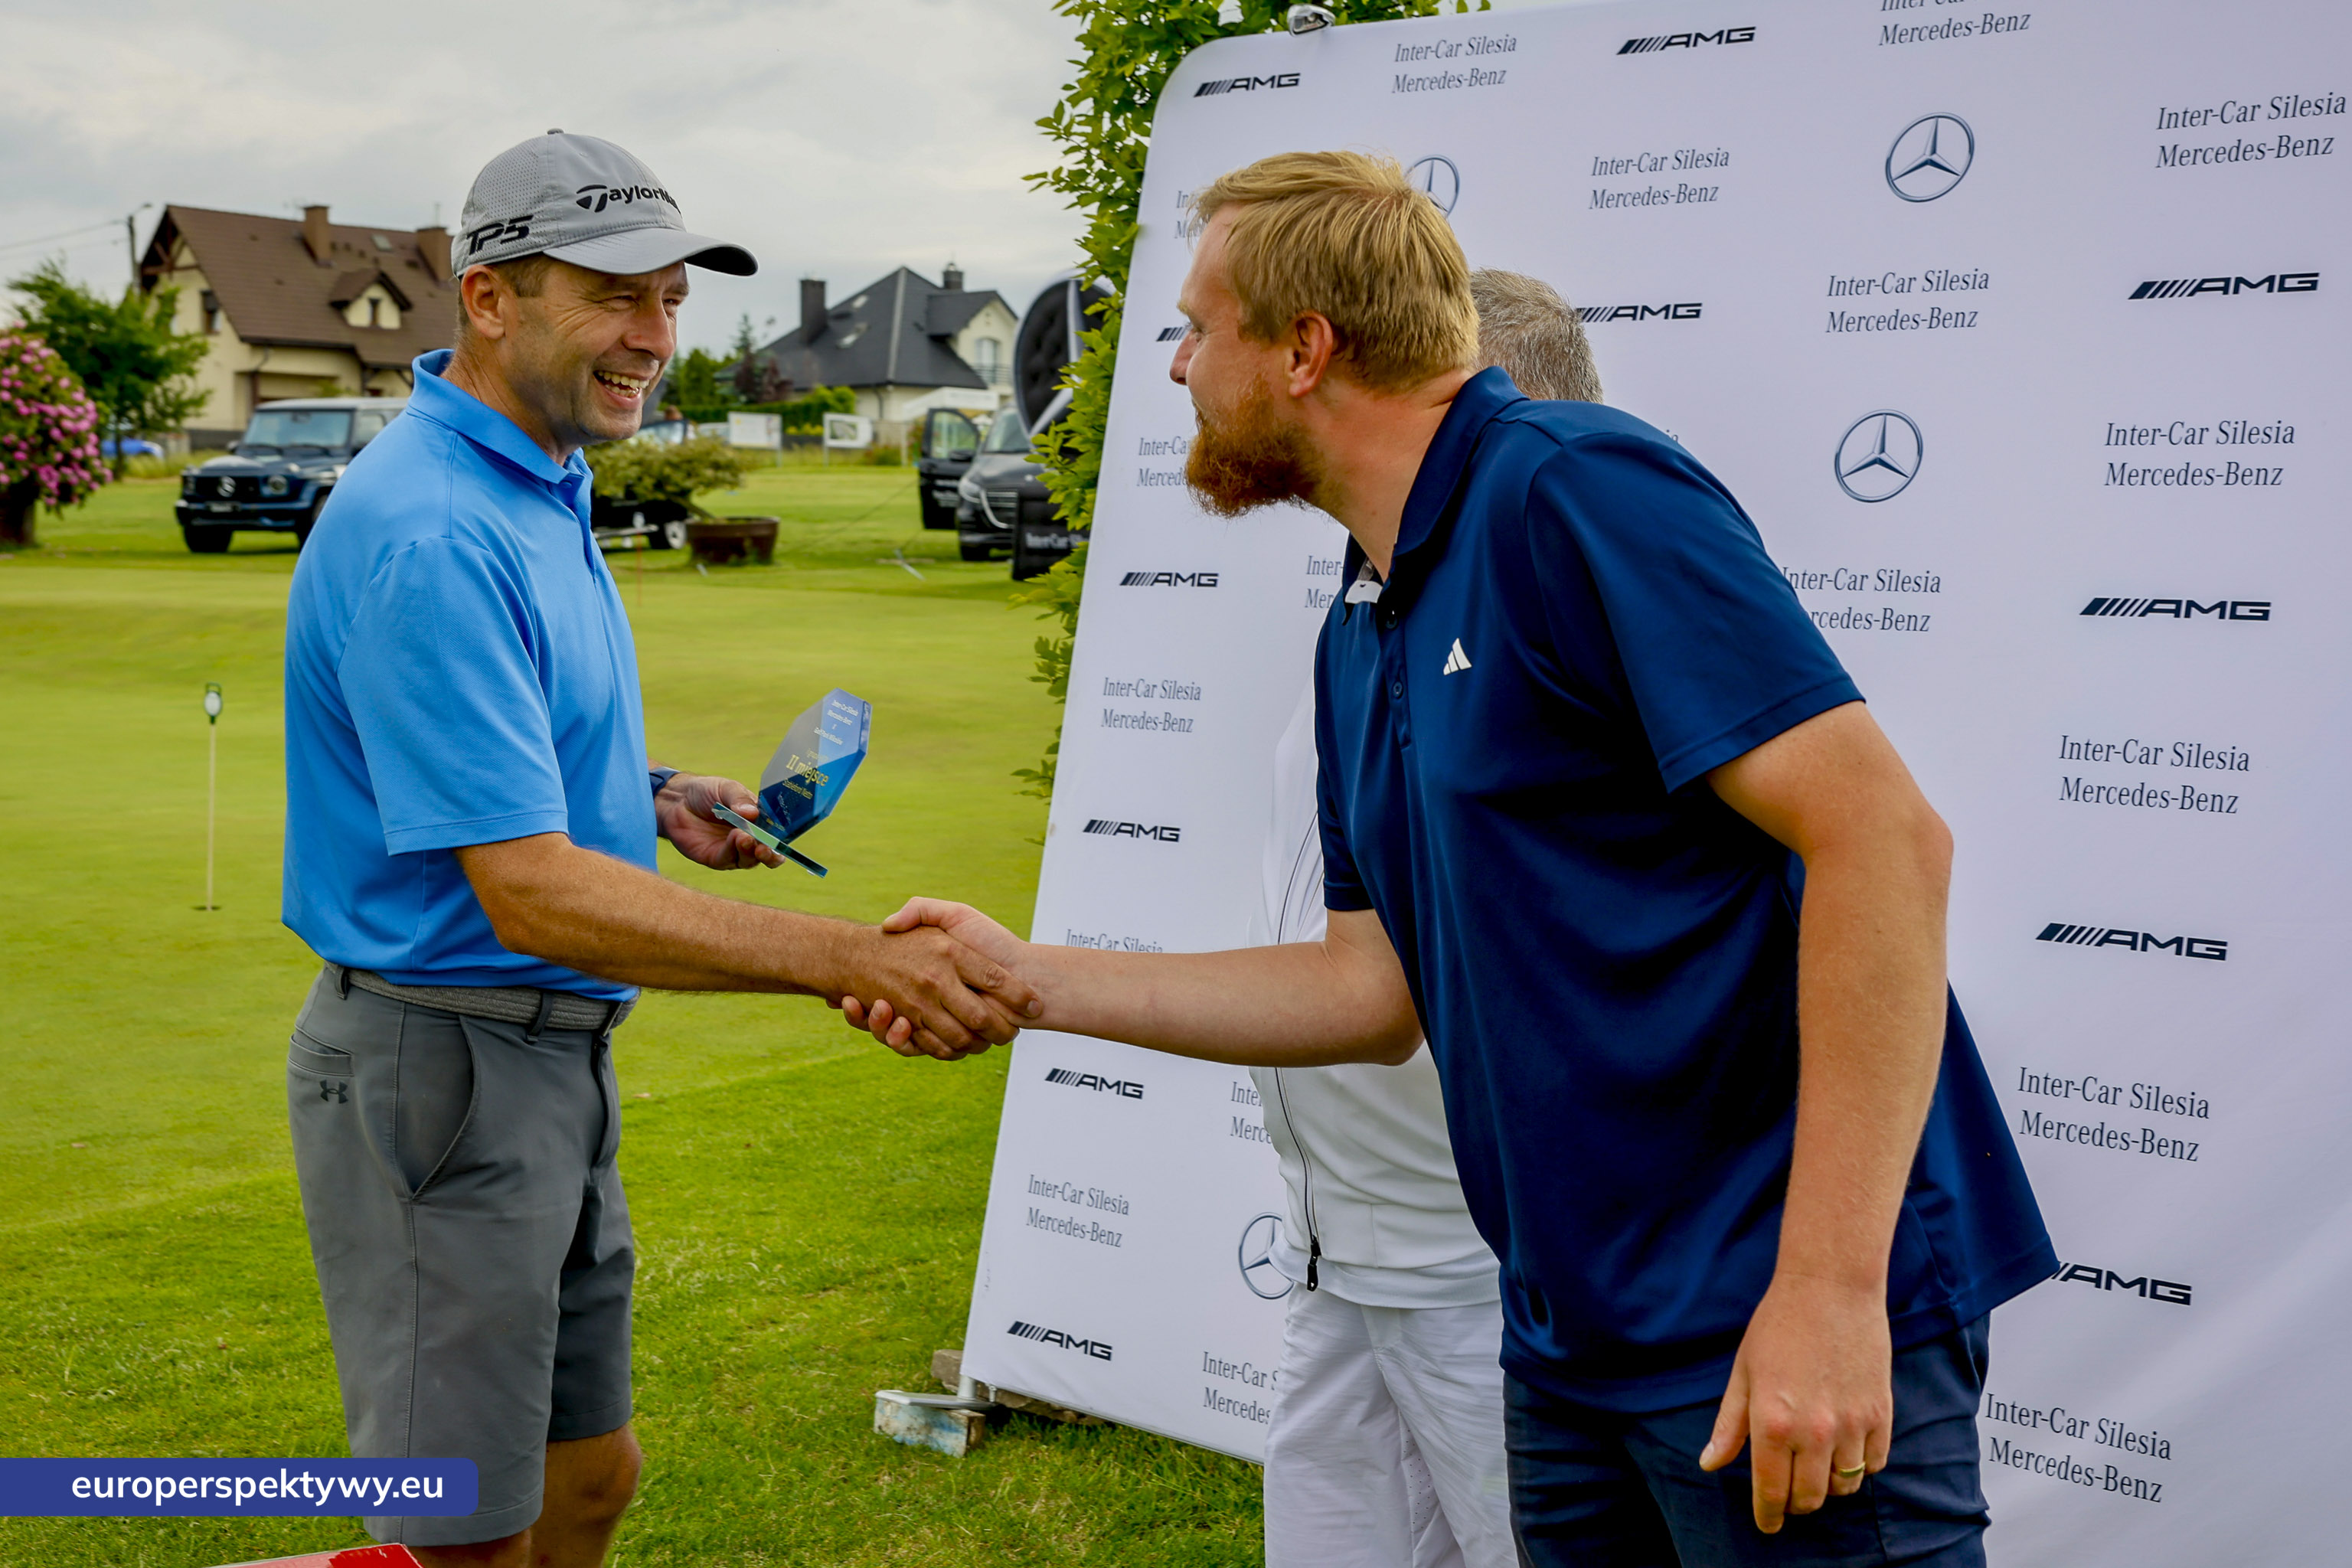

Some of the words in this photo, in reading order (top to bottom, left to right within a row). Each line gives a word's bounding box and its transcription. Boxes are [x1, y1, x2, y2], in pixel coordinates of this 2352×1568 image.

[1879, 13, 2032, 46] Mercedes-Benz
[1394, 39, 1462, 62] Inter-Car
[1465, 34, 1517, 56] Silesia
[1392, 67, 1507, 93] Mercedes-Benz
[2155, 100, 2262, 130] Inter-Car
[2267, 92, 2347, 120] Silesia
[1591, 151, 1668, 176] Inter-Car
[1671, 147, 1730, 172] Silesia
[2154, 134, 2335, 168] Mercedes-Benz
[1589, 183, 1719, 210] Mercedes-Benz
[466, 214, 534, 256] TP5
[1826, 272, 1917, 297] Inter-Car
[1922, 268, 1990, 292] Silesia
[1825, 307, 1978, 333] Mercedes-Benz
[1138, 436, 1186, 456] Inter-Ca
[2104, 421, 2210, 446] Inter-Car
[2215, 420, 2295, 446] Silesia
[2103, 462, 2284, 487] Mercedes-Benz
[1306, 555, 1344, 576] Inter-
[1873, 569, 1941, 593] Silesia
[1811, 606, 1931, 632] rcedes-Benz
[1103, 677, 1157, 699] Inter-Car
[1160, 680, 1201, 701] Silesia
[1101, 708, 1194, 733] Mercedes-Benz
[2059, 735, 2164, 766] Inter-Car
[2170, 742, 2250, 772] Silesia
[795, 762, 829, 786] miejsce
[2059, 776, 2239, 814] Mercedes-Benz
[2017, 1066, 2122, 1106] Inter-Car
[2129, 1083, 2210, 1119] Silesia
[2019, 1109, 2200, 1162] Mercedes-Benz
[1027, 1174, 1083, 1205] Inter-Car
[1086, 1187, 1129, 1216] Silesia
[1026, 1207, 1122, 1248] Mercedes-Benz
[1203, 1351, 1268, 1388] Inter-Car
[1203, 1387, 1271, 1425] Mercedes
[1984, 1393, 2089, 1440] Inter-Car
[2094, 1418, 2172, 1461] Silesia
[1988, 1437, 2162, 1503] Mercedes-Benz
